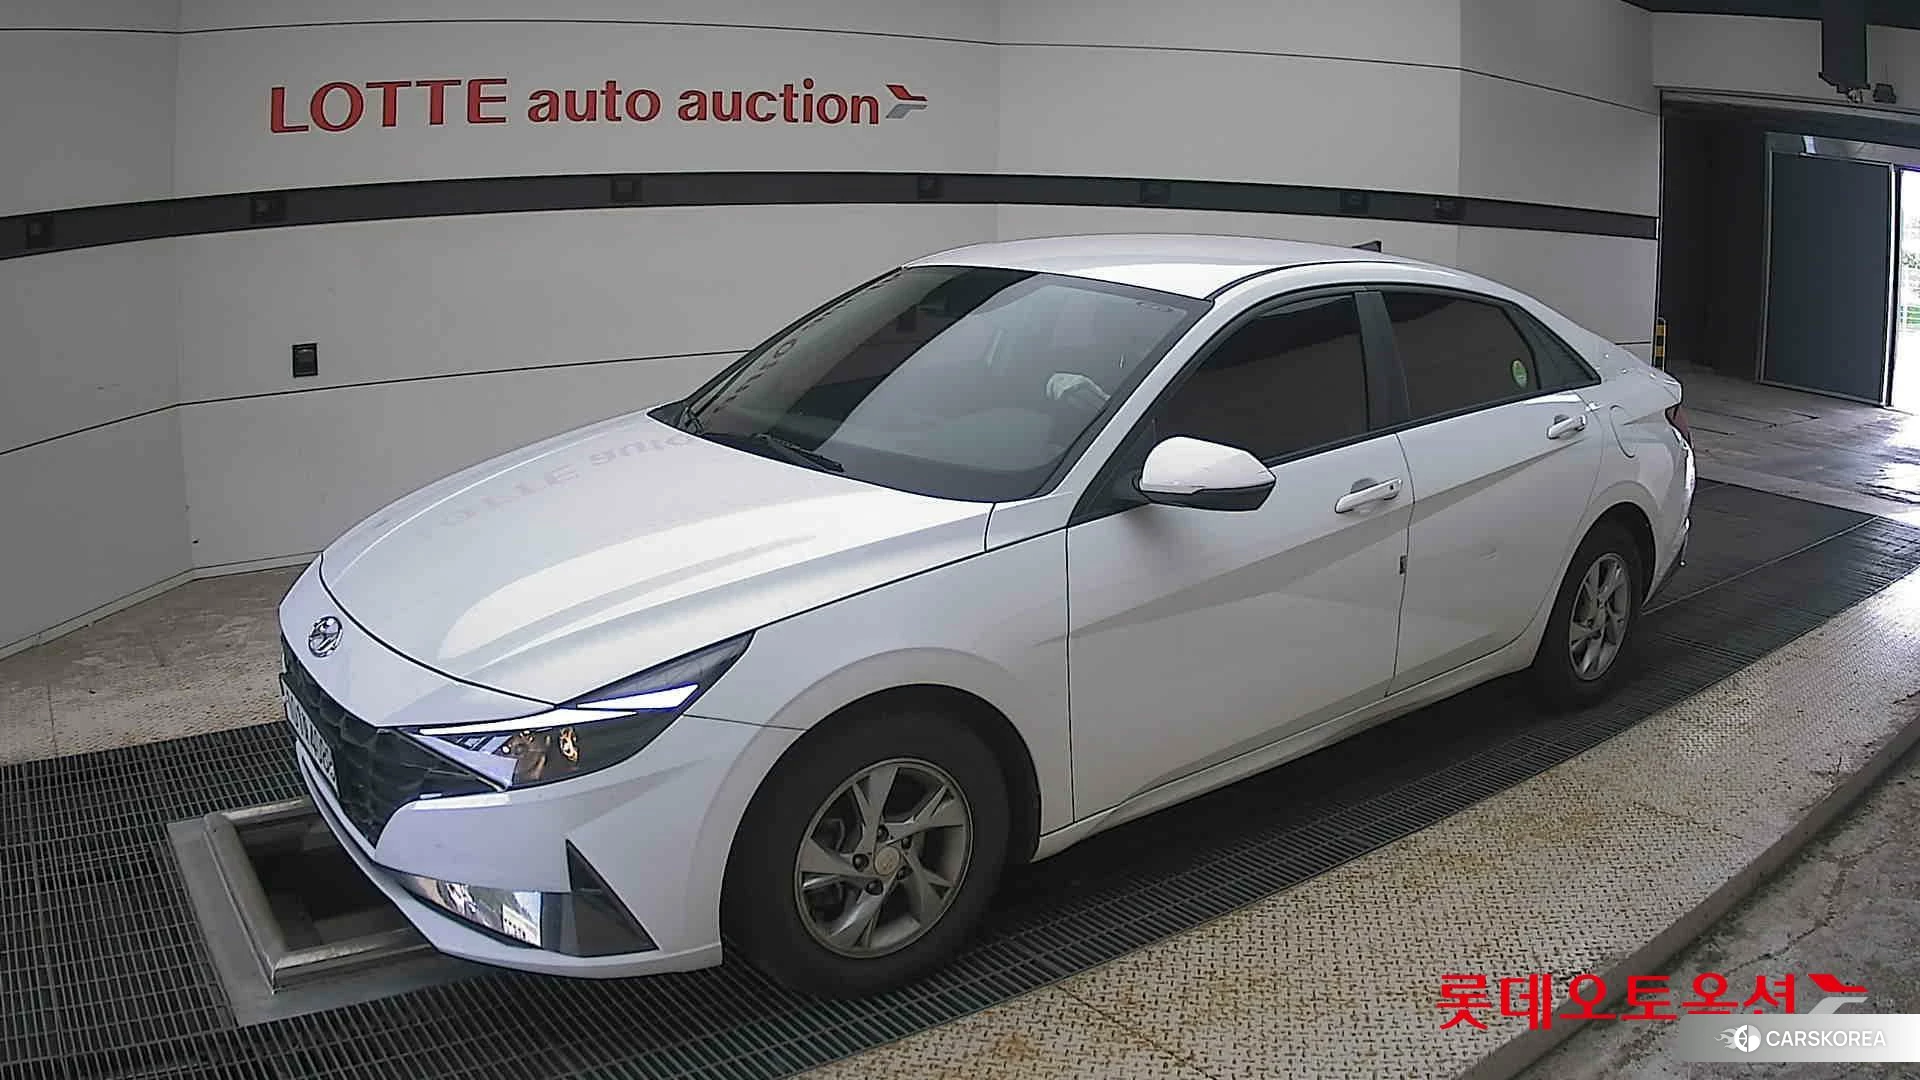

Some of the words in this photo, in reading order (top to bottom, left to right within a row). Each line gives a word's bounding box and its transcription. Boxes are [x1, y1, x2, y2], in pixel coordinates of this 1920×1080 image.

[270, 79, 508, 134] LOTTE
[527, 80, 661, 122] auto
[677, 78, 880, 125] auction
